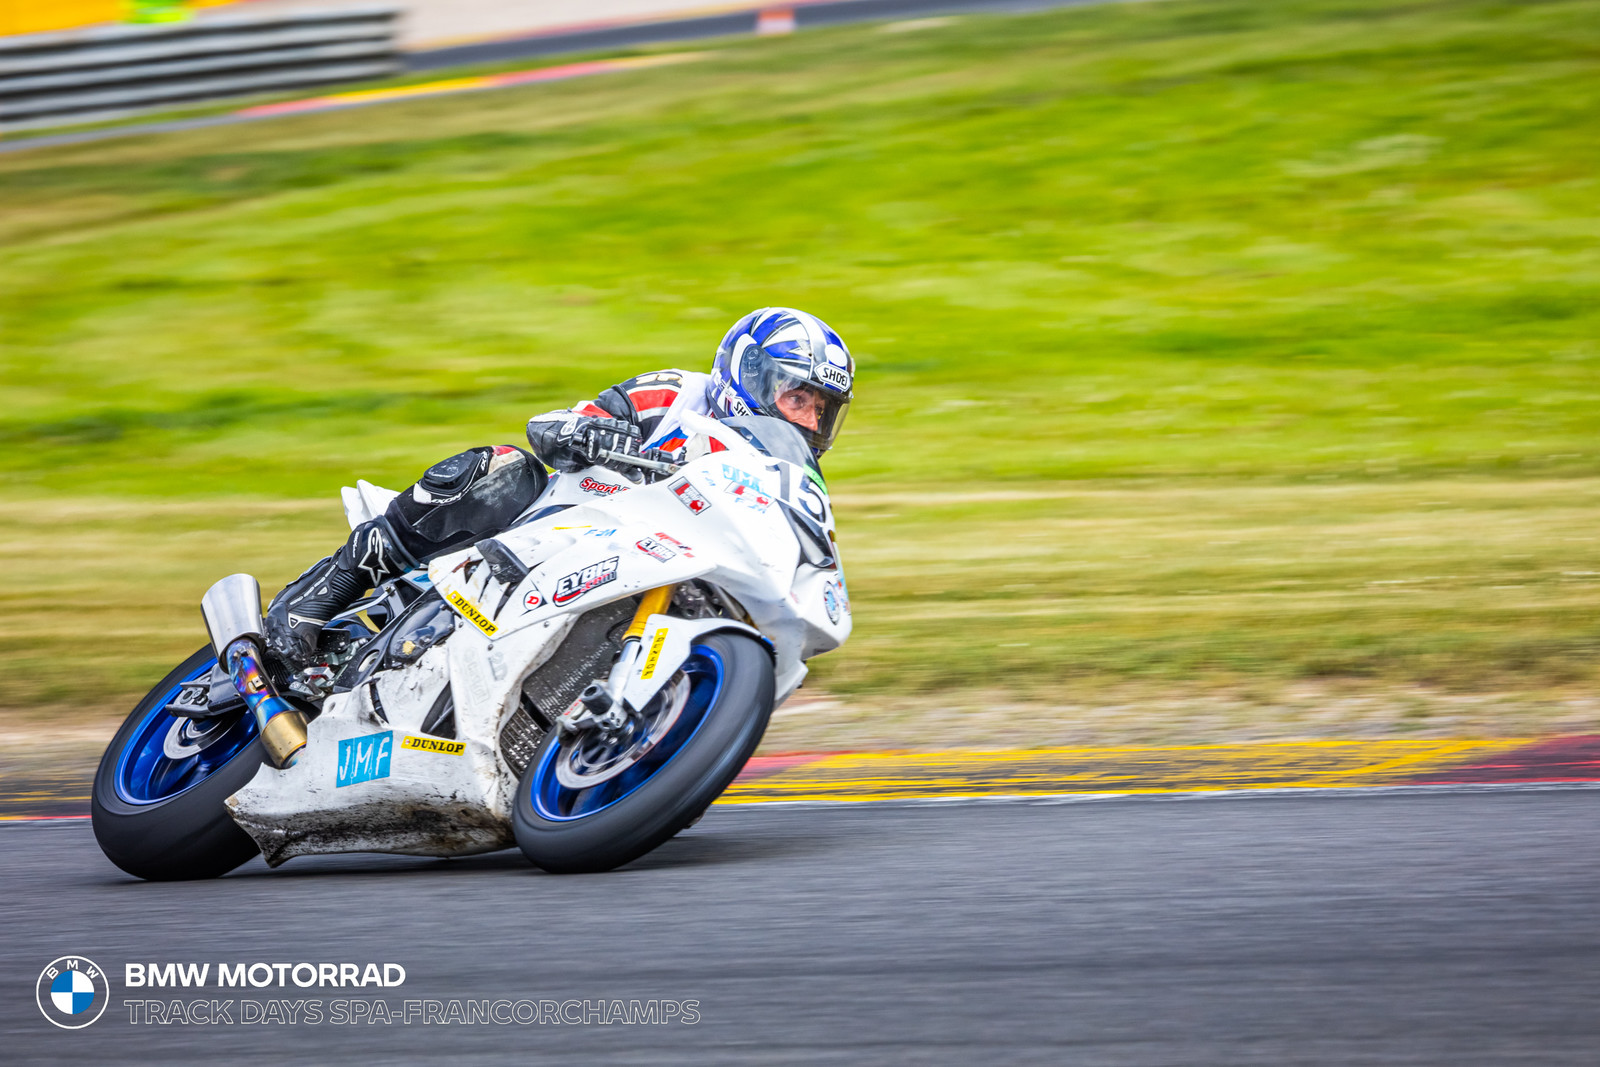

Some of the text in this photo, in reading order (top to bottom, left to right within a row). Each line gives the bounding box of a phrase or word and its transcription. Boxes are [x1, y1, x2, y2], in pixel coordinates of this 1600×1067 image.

[580, 477, 629, 495] Sport
[557, 558, 619, 595] EYBIS
[454, 598, 496, 634] DUNLOP
[339, 736, 390, 781] JMF
[411, 738, 464, 754] DUNLOP
